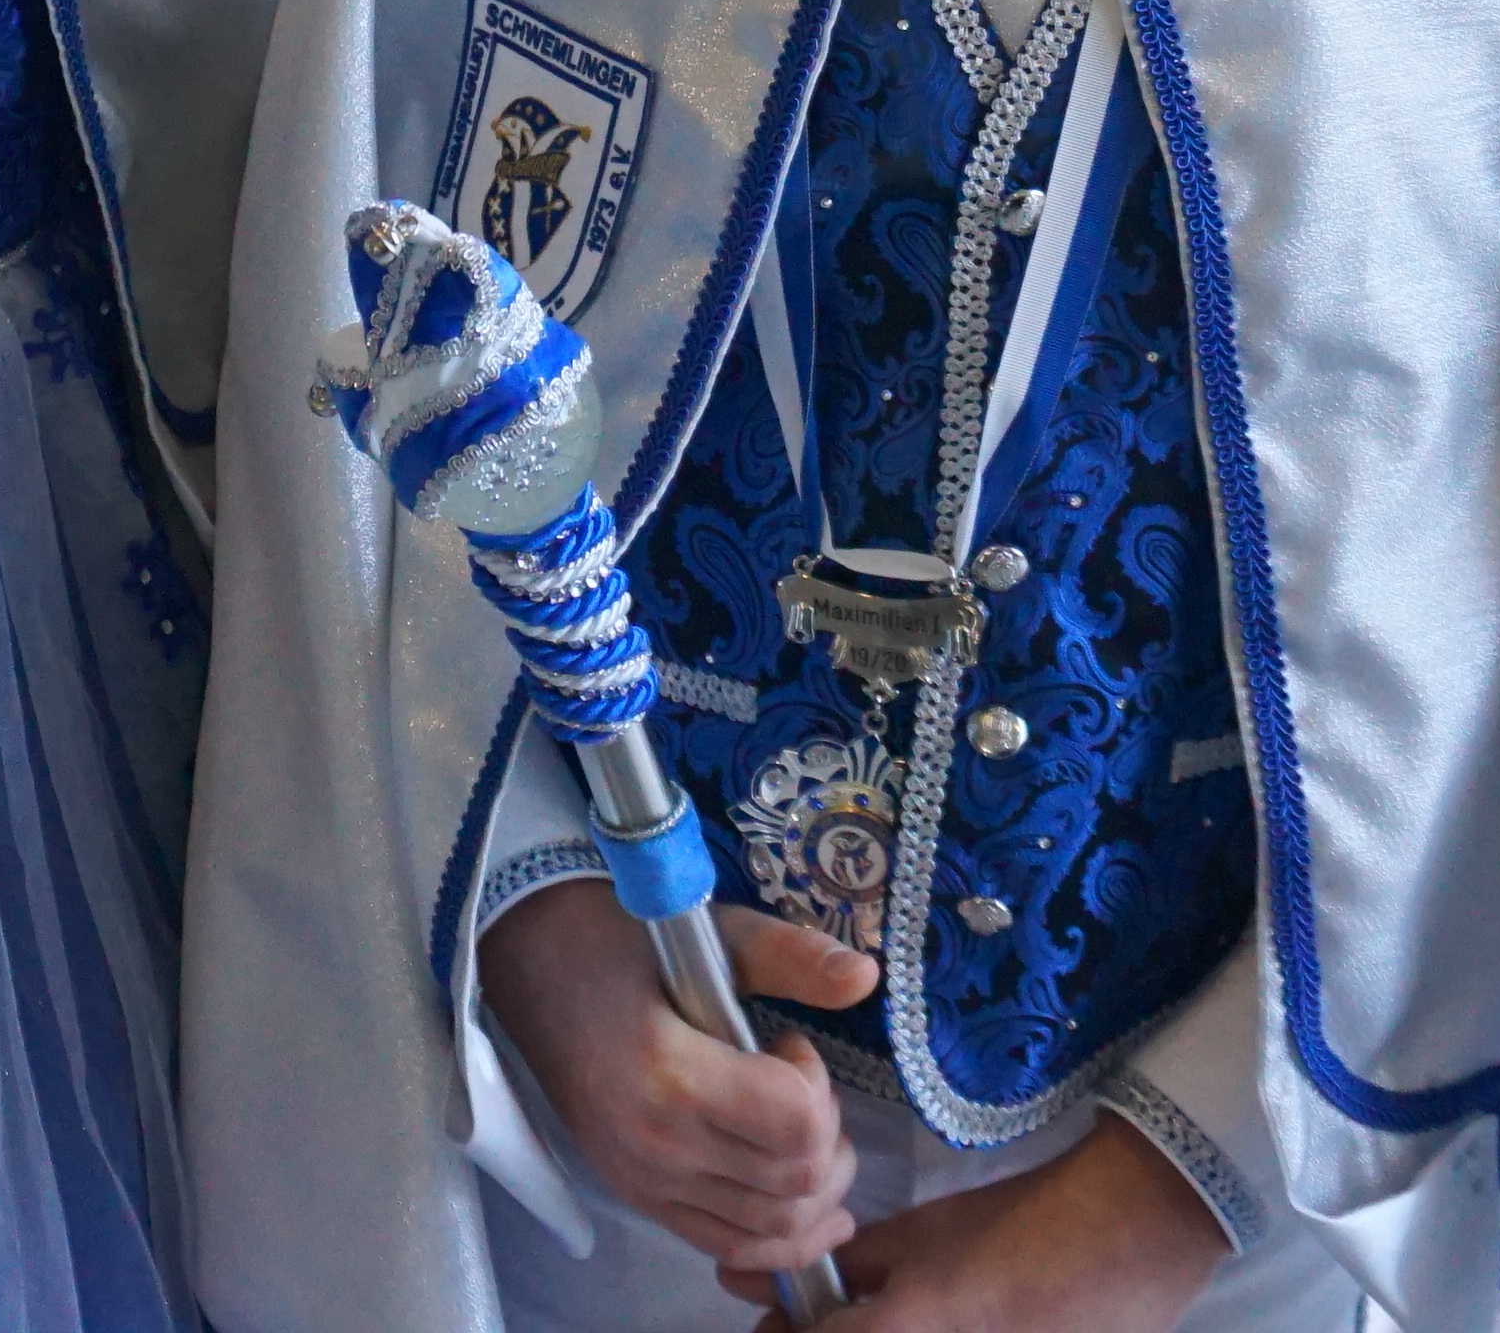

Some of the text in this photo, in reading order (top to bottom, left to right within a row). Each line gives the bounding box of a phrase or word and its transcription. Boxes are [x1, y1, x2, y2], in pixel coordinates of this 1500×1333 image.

[486, 3, 637, 99] SCHWEMLINGEN
[587, 198, 616, 252] 1973
[813, 597, 927, 632] Maximilian
[851, 645, 908, 674] 19/20
